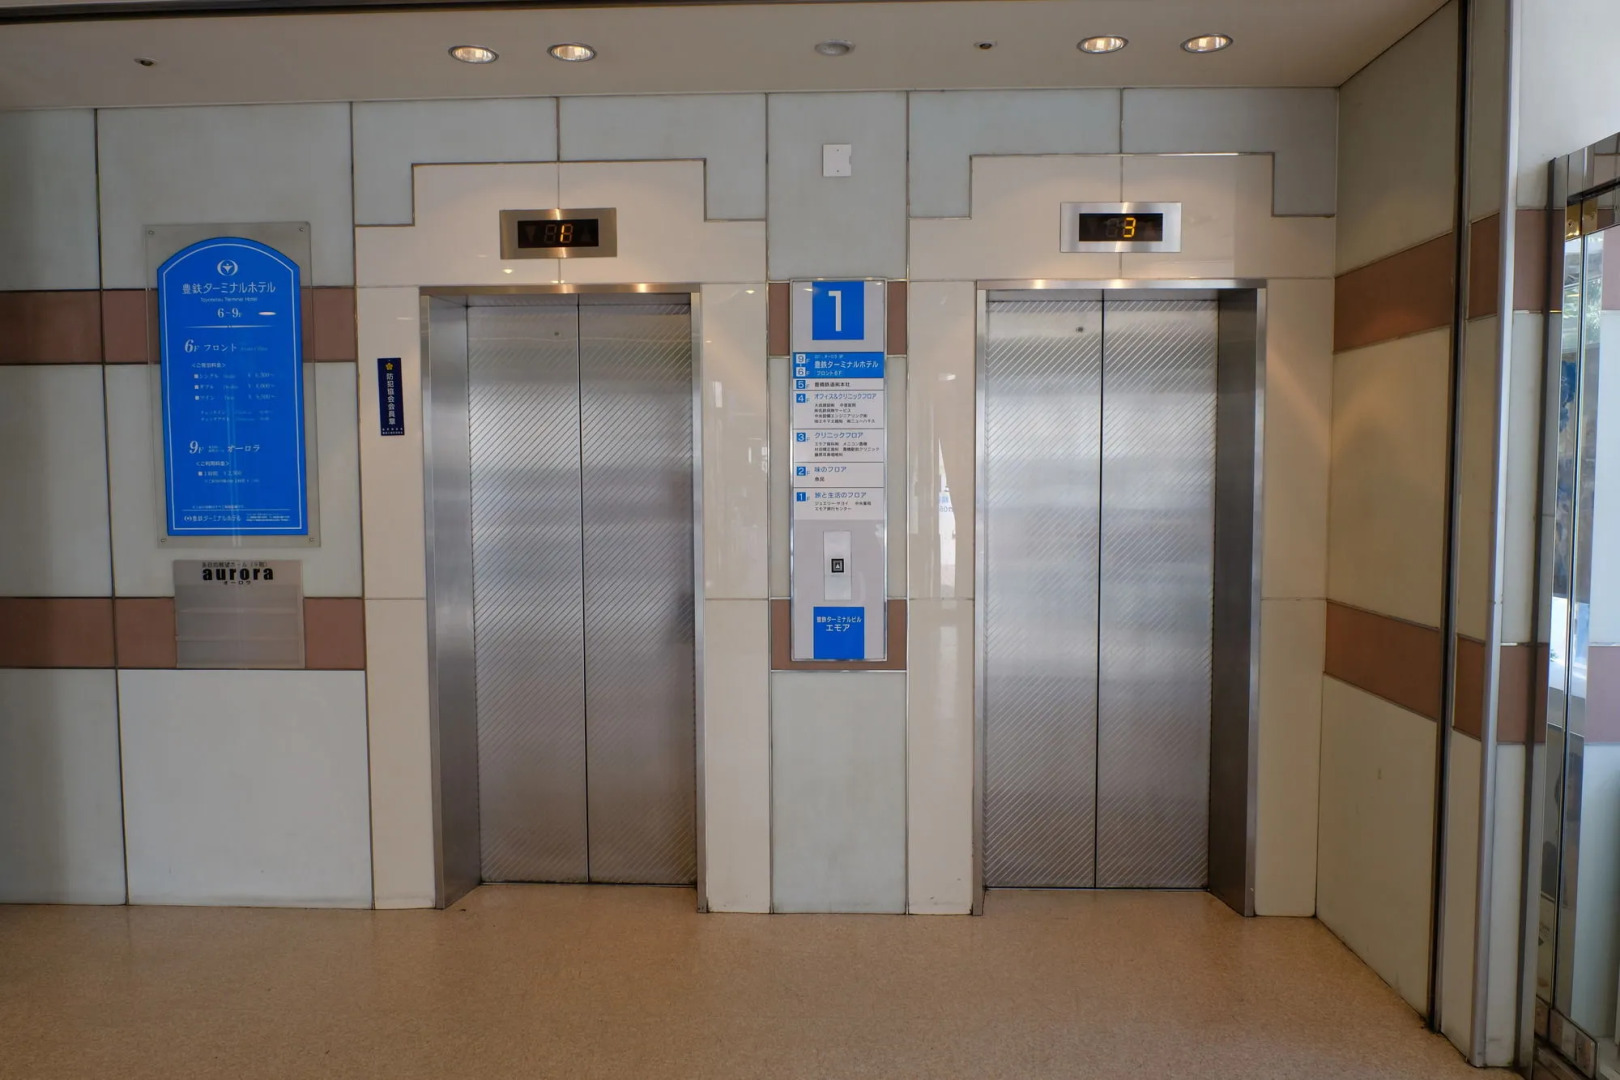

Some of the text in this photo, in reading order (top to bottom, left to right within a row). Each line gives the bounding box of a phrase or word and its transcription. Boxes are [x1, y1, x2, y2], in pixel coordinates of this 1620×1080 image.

[1123, 217, 1136, 238] 3
[182, 281, 276, 295] 豊鉄ターミナルホテル
[828, 290, 842, 332] 1
[184, 339, 200, 353] 6F
[203, 343, 237, 352] フロント
[814, 360, 879, 369] 豊鉄ターミナルホテル
[189, 440, 204, 454] 9F
[227, 444, 261, 453] オーロラ
[202, 568, 274, 581] aurora
[825, 624, 851, 632] エモア
